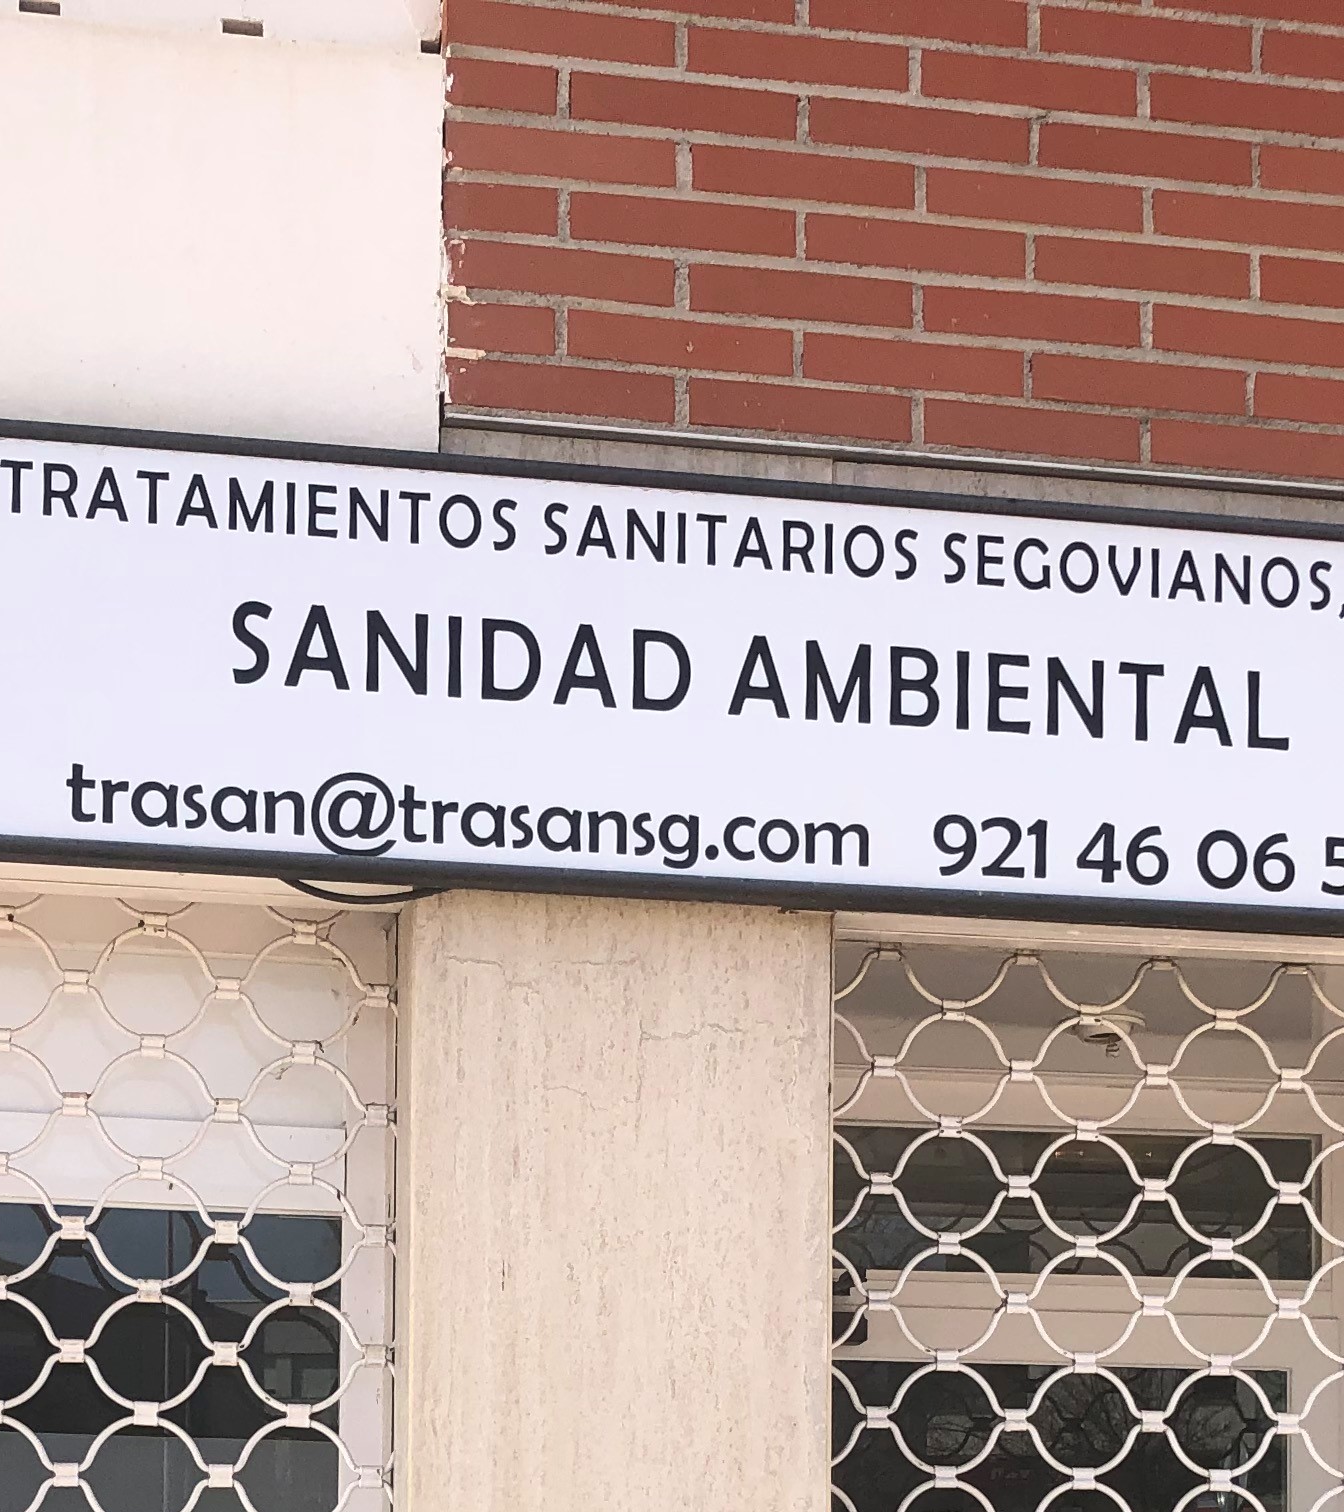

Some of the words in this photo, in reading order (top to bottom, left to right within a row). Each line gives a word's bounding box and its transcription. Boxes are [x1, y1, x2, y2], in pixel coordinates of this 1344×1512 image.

[0, 460, 517, 551] TRATAMIENTOS
[544, 503, 918, 580] SANITARIOS
[233, 601, 691, 711] SANIDAD
[728, 635, 1289, 750] AMBIENTAL
[66, 764, 869, 869] trasan@trasansg.com
[934, 815, 1047, 878] 921
[1077, 823, 1168, 885] 46
[1197, 830, 1295, 892] 06
